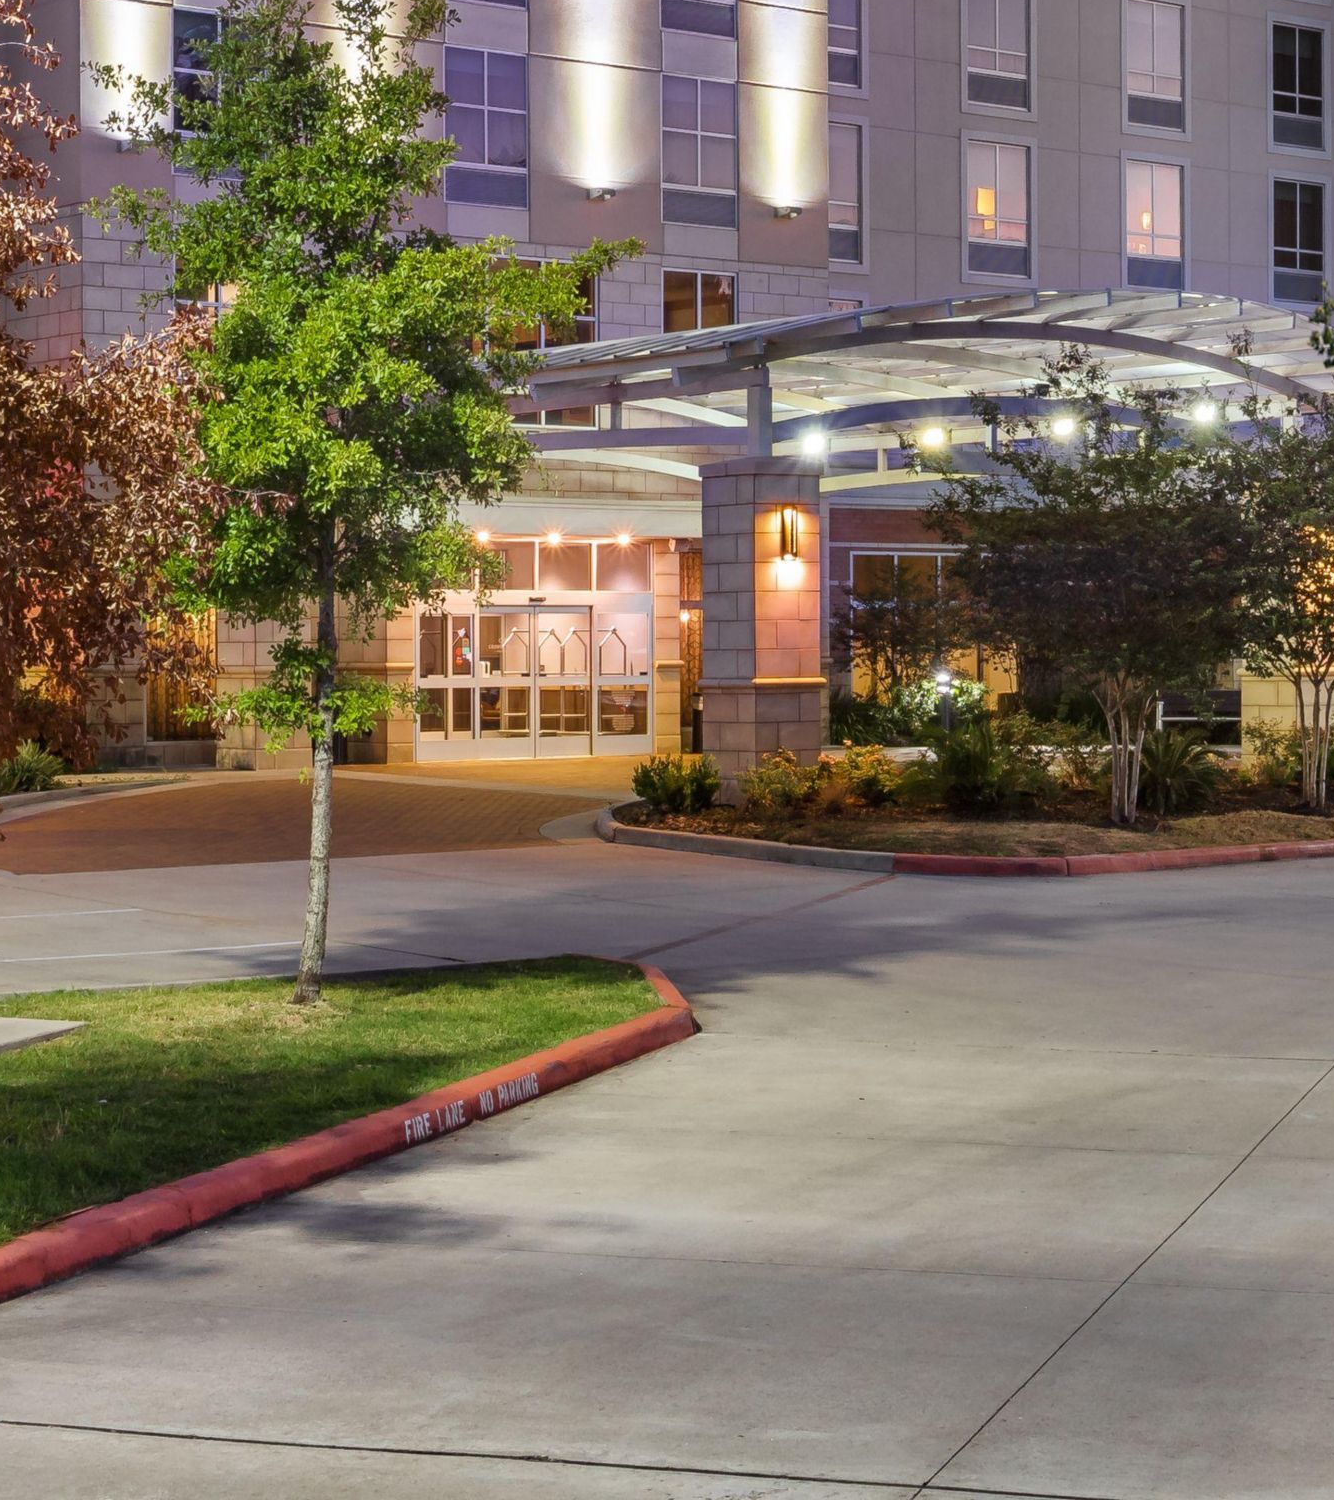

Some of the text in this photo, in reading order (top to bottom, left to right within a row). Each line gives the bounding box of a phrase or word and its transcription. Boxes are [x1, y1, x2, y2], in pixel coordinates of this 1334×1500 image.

[404, 1072, 539, 1145] FIRE LANE NO PARKING
